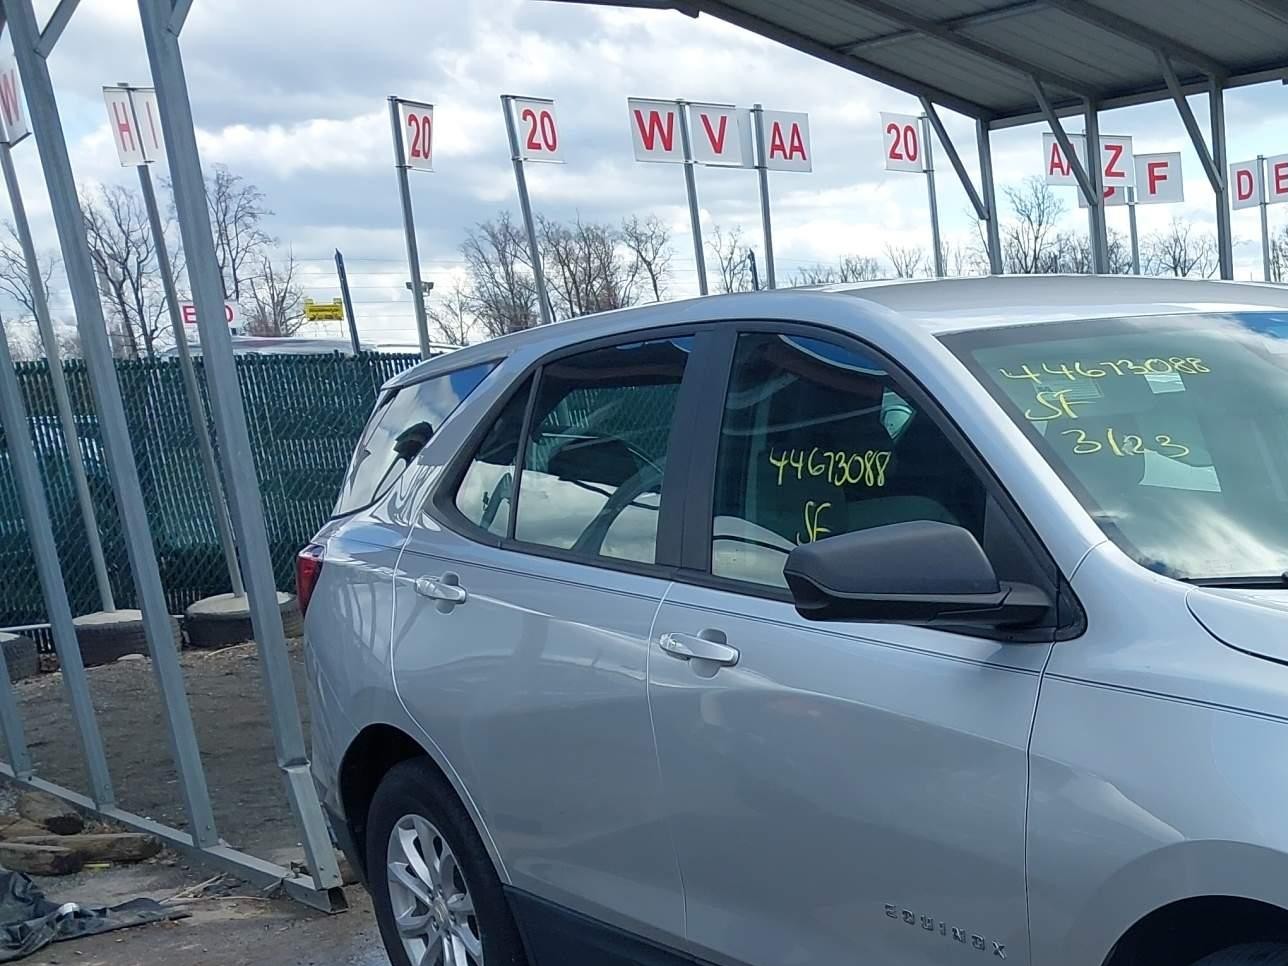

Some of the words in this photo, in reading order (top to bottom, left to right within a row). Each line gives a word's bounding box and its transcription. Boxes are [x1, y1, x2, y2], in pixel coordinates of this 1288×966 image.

[112, 101, 136, 153] H
[407, 113, 432, 160] 20
[521, 108, 558, 152] 20
[633, 109, 675, 152] W
[700, 113, 728, 155] V
[769, 121, 808, 161] AA
[886, 122, 919, 162] 20
[1104, 144, 1125, 178] Z
[1147, 161, 1169, 195] F
[1236, 169, 1254, 201] D
[999, 356, 1211, 385] 44673088
[1024, 388, 1097, 421] SF
[769, 447, 892, 487] 44673088
[884, 902, 1008, 960] EQUINOX
